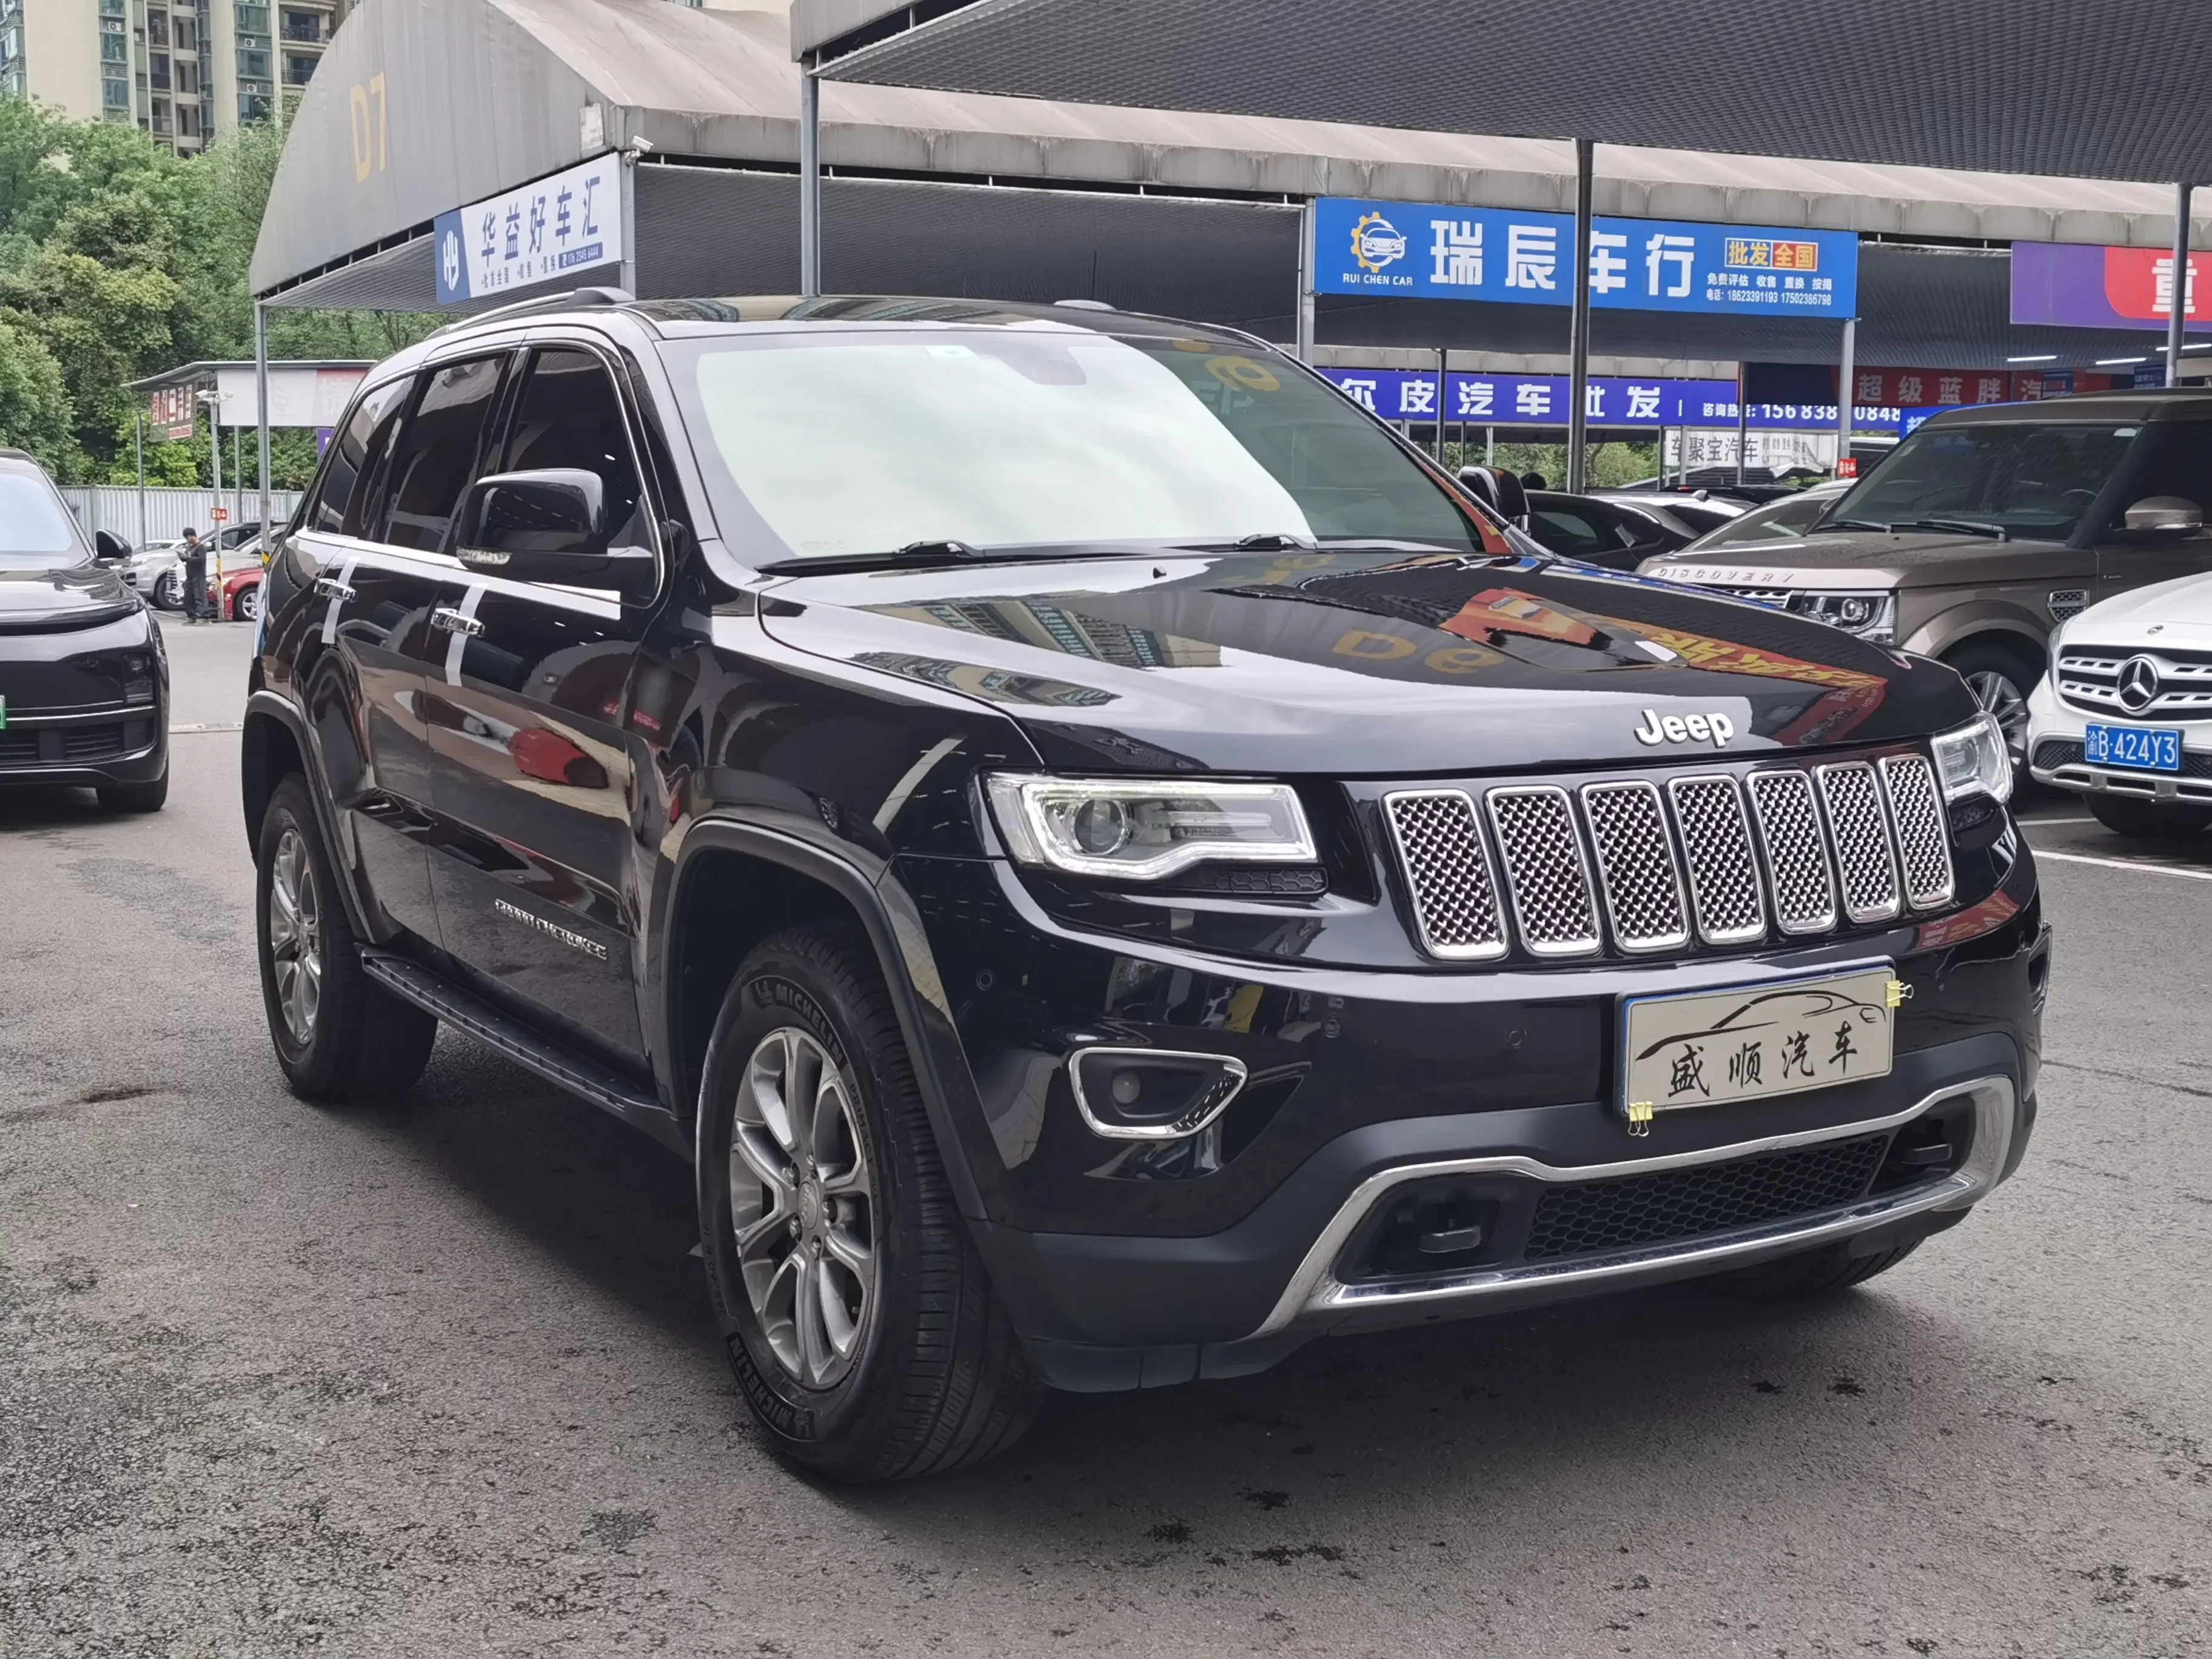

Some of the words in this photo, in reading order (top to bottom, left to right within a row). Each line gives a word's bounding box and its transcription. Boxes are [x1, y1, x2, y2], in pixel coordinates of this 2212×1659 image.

[349, 72, 386, 183] D7
[481, 176, 600, 268] 华益好车汇
[1430, 220, 1695, 298] 瑞辰车行
[1729, 240, 1770, 266] 批发
[1774, 243, 1814, 268] 全国
[1342, 273, 1360, 284] RUI
[1363, 274, 1390, 286] CHEN
[1393, 276, 1413, 286] CAR
[1657, 569, 1795, 583] DISCOVERY
[1634, 708, 1734, 749] Jeep
[776, 982, 845, 1068] MICHELIN
[1667, 1020, 1858, 1099] 盛顺汽车
[728, 1336, 793, 1429] MICHELIN
